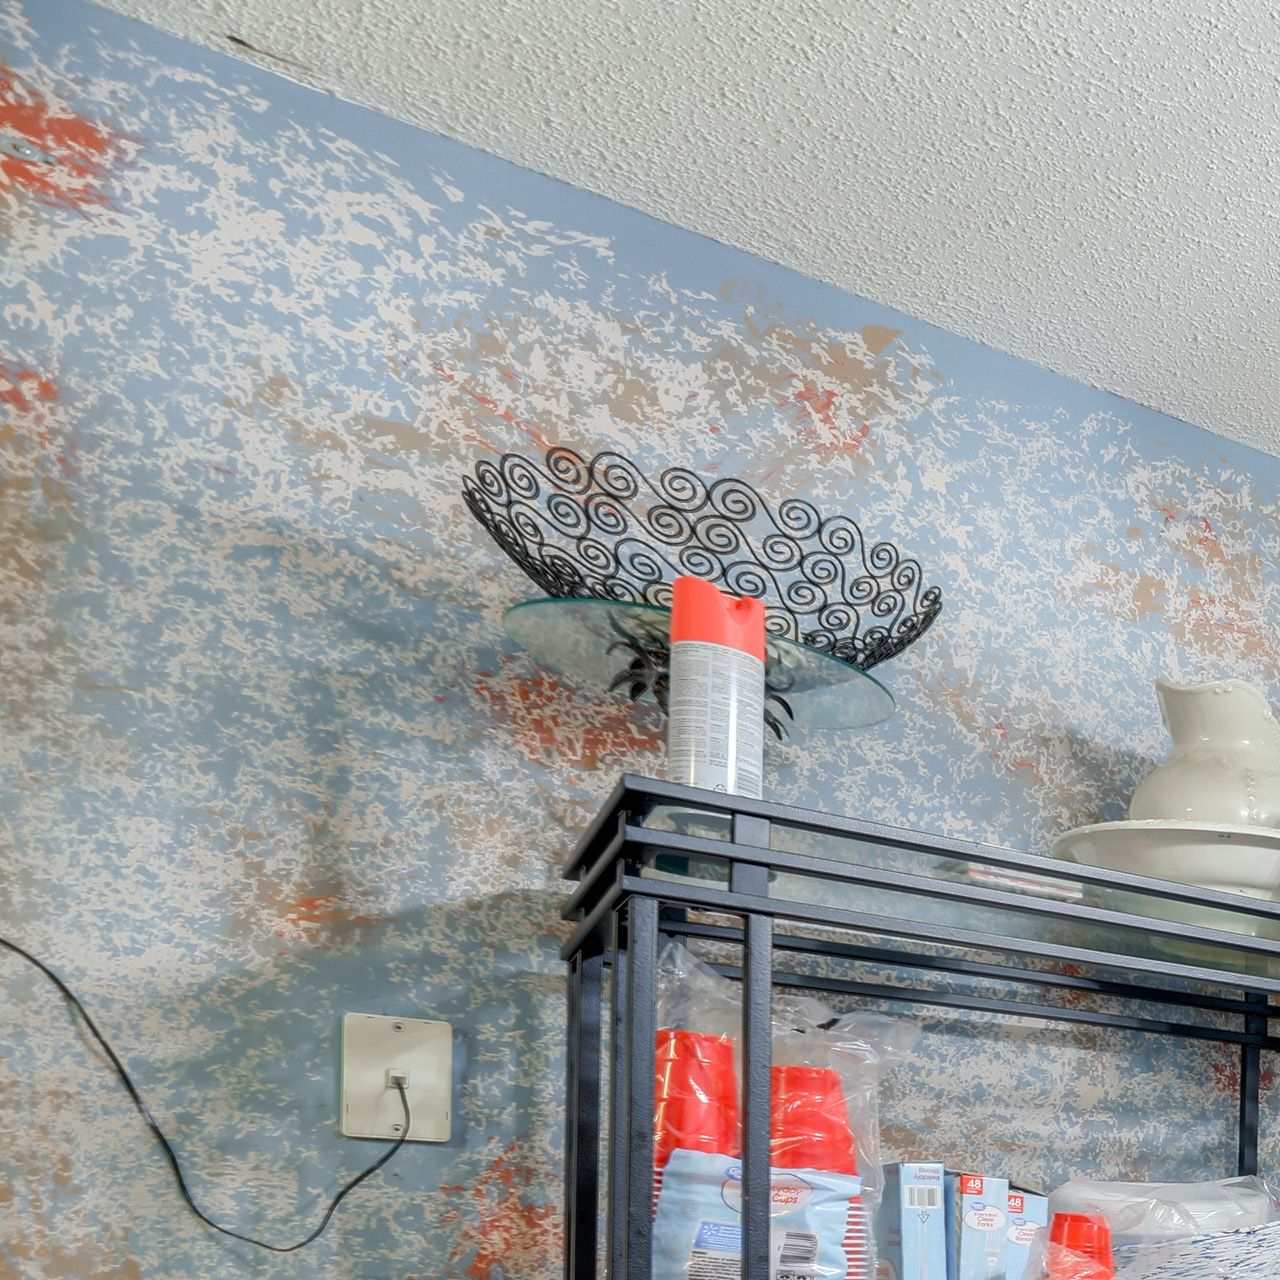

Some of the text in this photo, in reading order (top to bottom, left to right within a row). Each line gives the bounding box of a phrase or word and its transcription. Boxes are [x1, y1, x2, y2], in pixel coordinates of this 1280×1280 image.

[968, 1180, 981, 1189] 48
[772, 1194, 798, 1205] Cups
[1008, 1198, 1021, 1206] 48
